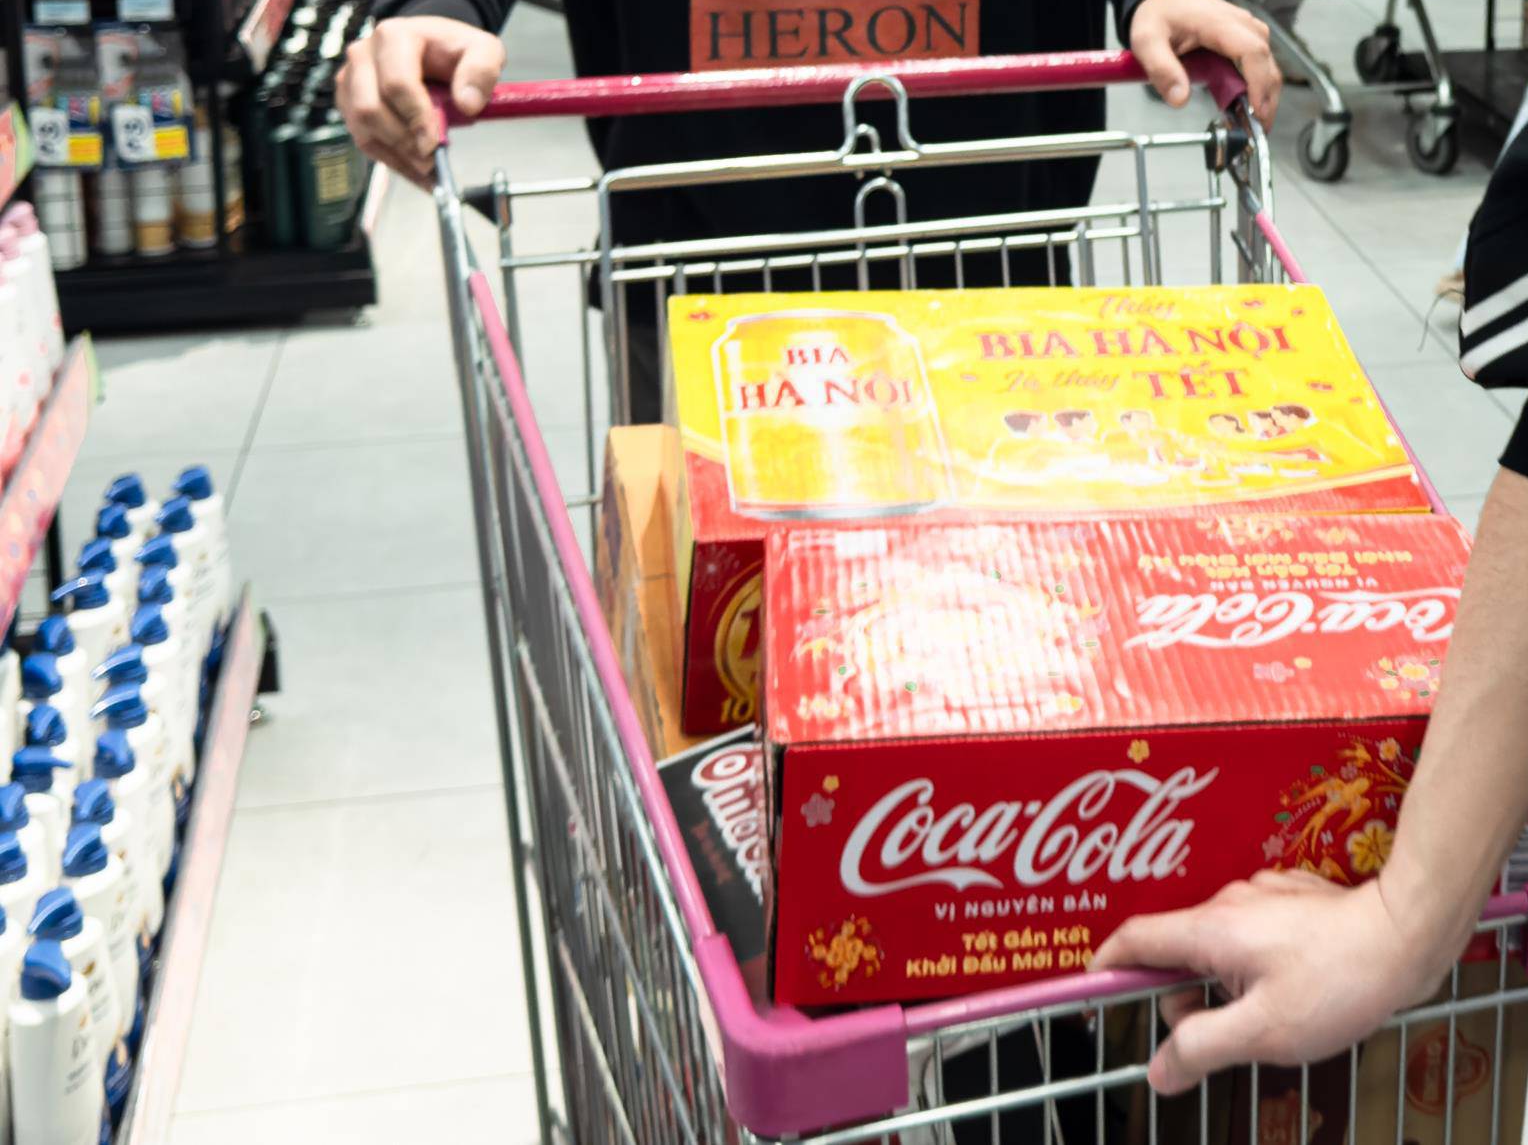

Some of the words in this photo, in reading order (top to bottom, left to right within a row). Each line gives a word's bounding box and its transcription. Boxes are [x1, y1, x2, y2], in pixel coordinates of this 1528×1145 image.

[707, 1, 968, 62] HERON
[784, 346, 850, 367] BIA
[976, 330, 1080, 359] BIA
[1088, 320, 1178, 357] HÀ
[1185, 320, 1297, 360] NỘI
[738, 371, 806, 411] HÀ
[823, 370, 915, 413] NỘI
[1132, 360, 1249, 400] TẾT
[839, 766, 1221, 898] Coca-Cola
[934, 901, 956, 923] VỊ
[964, 895, 1055, 919] NGUYÊN
[1063, 889, 1107, 913] BẢN
[962, 929, 998, 952] Tết
[1004, 927, 1047, 949] Gắn
[1053, 923, 1091, 947] Kết
[905, 955, 957, 979] Khởi
[962, 951, 1007, 975] Đầu
[1012, 947, 1054, 972] Mới
